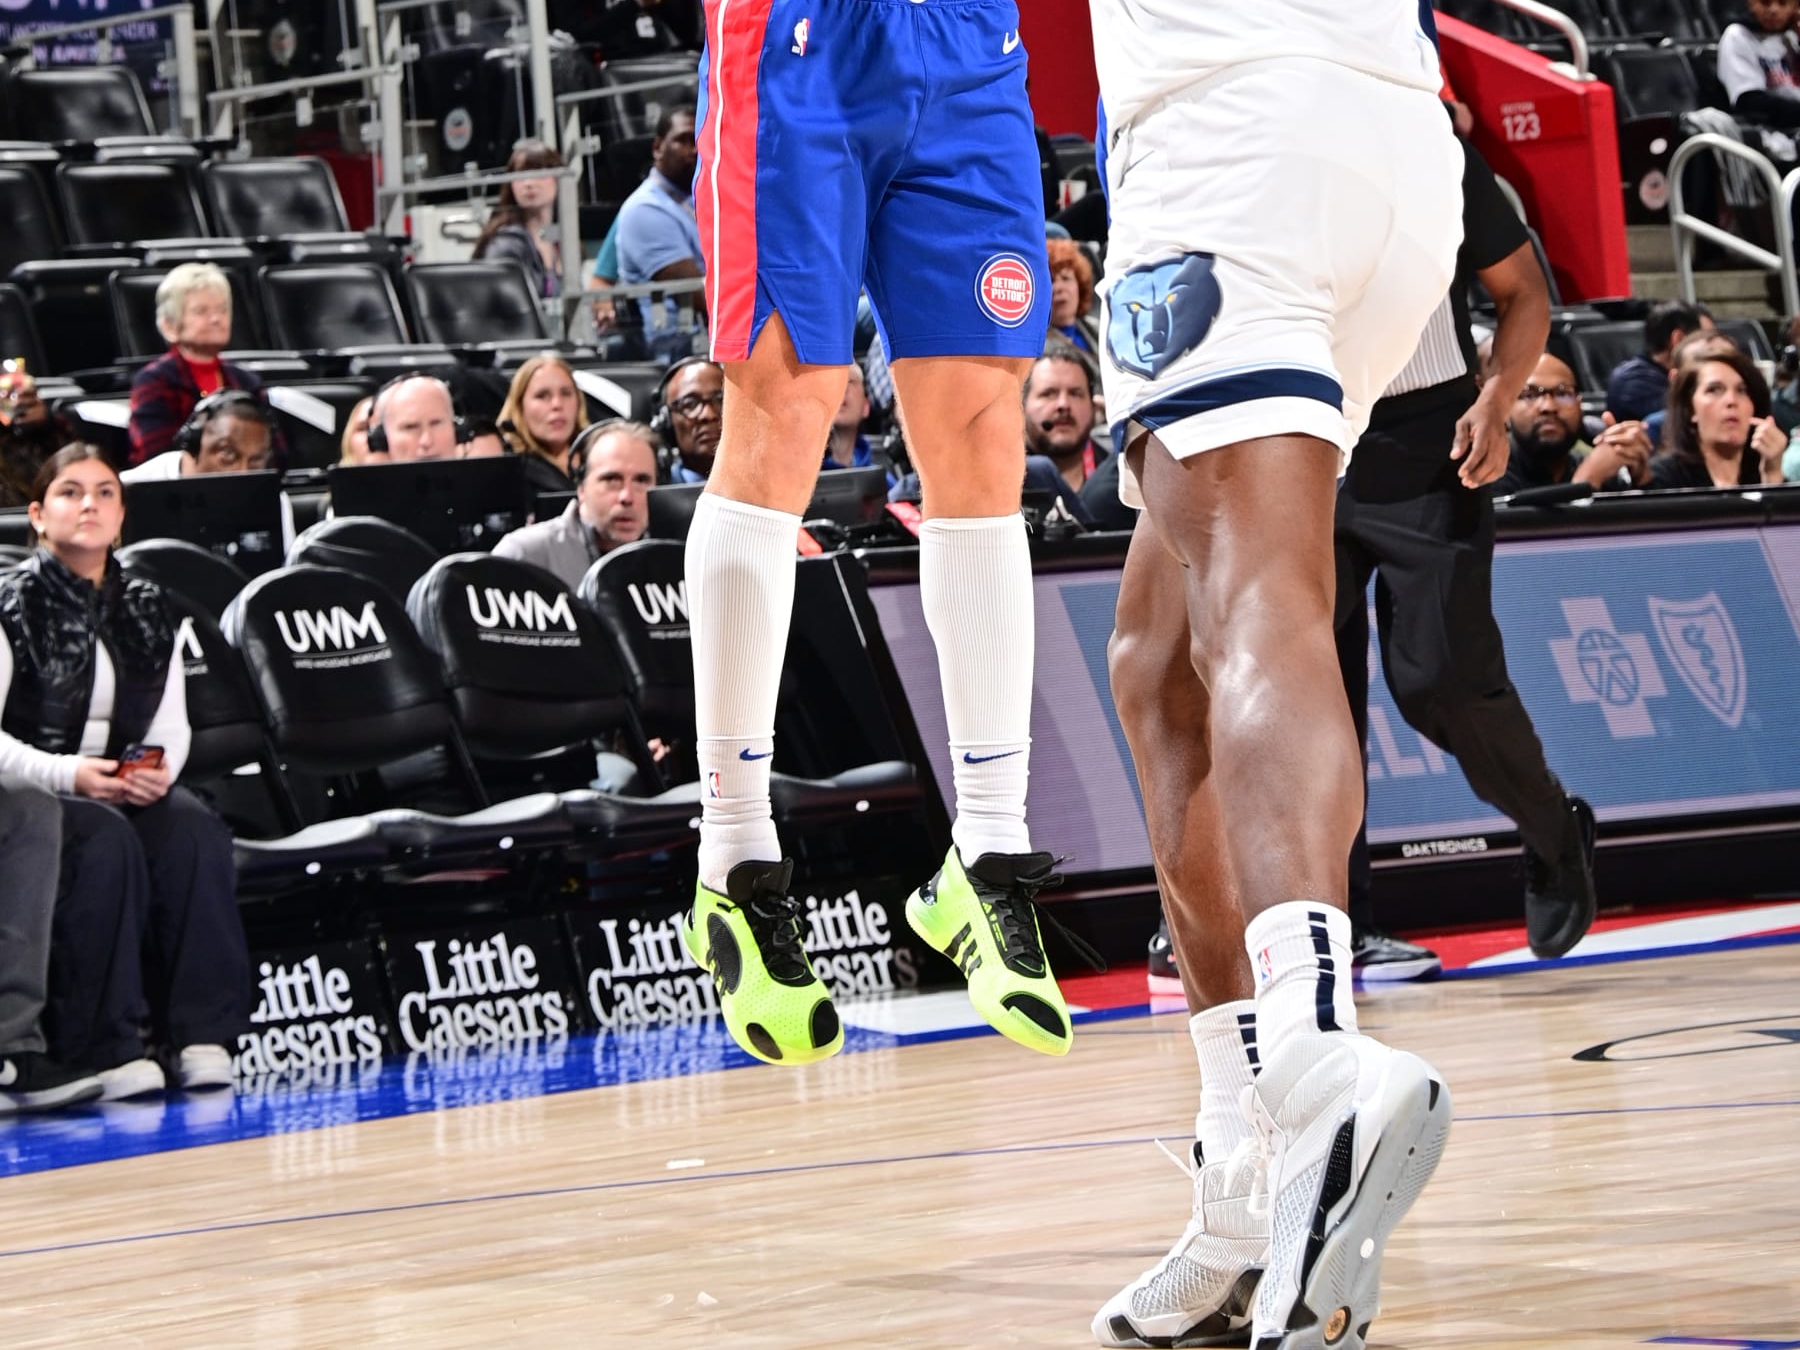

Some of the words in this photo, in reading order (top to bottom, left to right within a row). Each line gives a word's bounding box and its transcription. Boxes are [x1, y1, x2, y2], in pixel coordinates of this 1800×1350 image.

[1503, 113, 1541, 141] 123
[991, 288, 1026, 303] PISTONS
[992, 276, 1026, 291] DETROIT
[274, 600, 387, 653] UWM
[466, 584, 577, 632] UWM
[627, 580, 690, 624] UW
[1401, 837, 1488, 858] DAKTRONICS
[415, 931, 539, 1000] Little
[600, 911, 698, 978] Littl
[588, 968, 722, 1028] Caesar
[813, 948, 918, 999] esars
[232, 1015, 383, 1077] aesars
[399, 991, 569, 1052] Caesars
